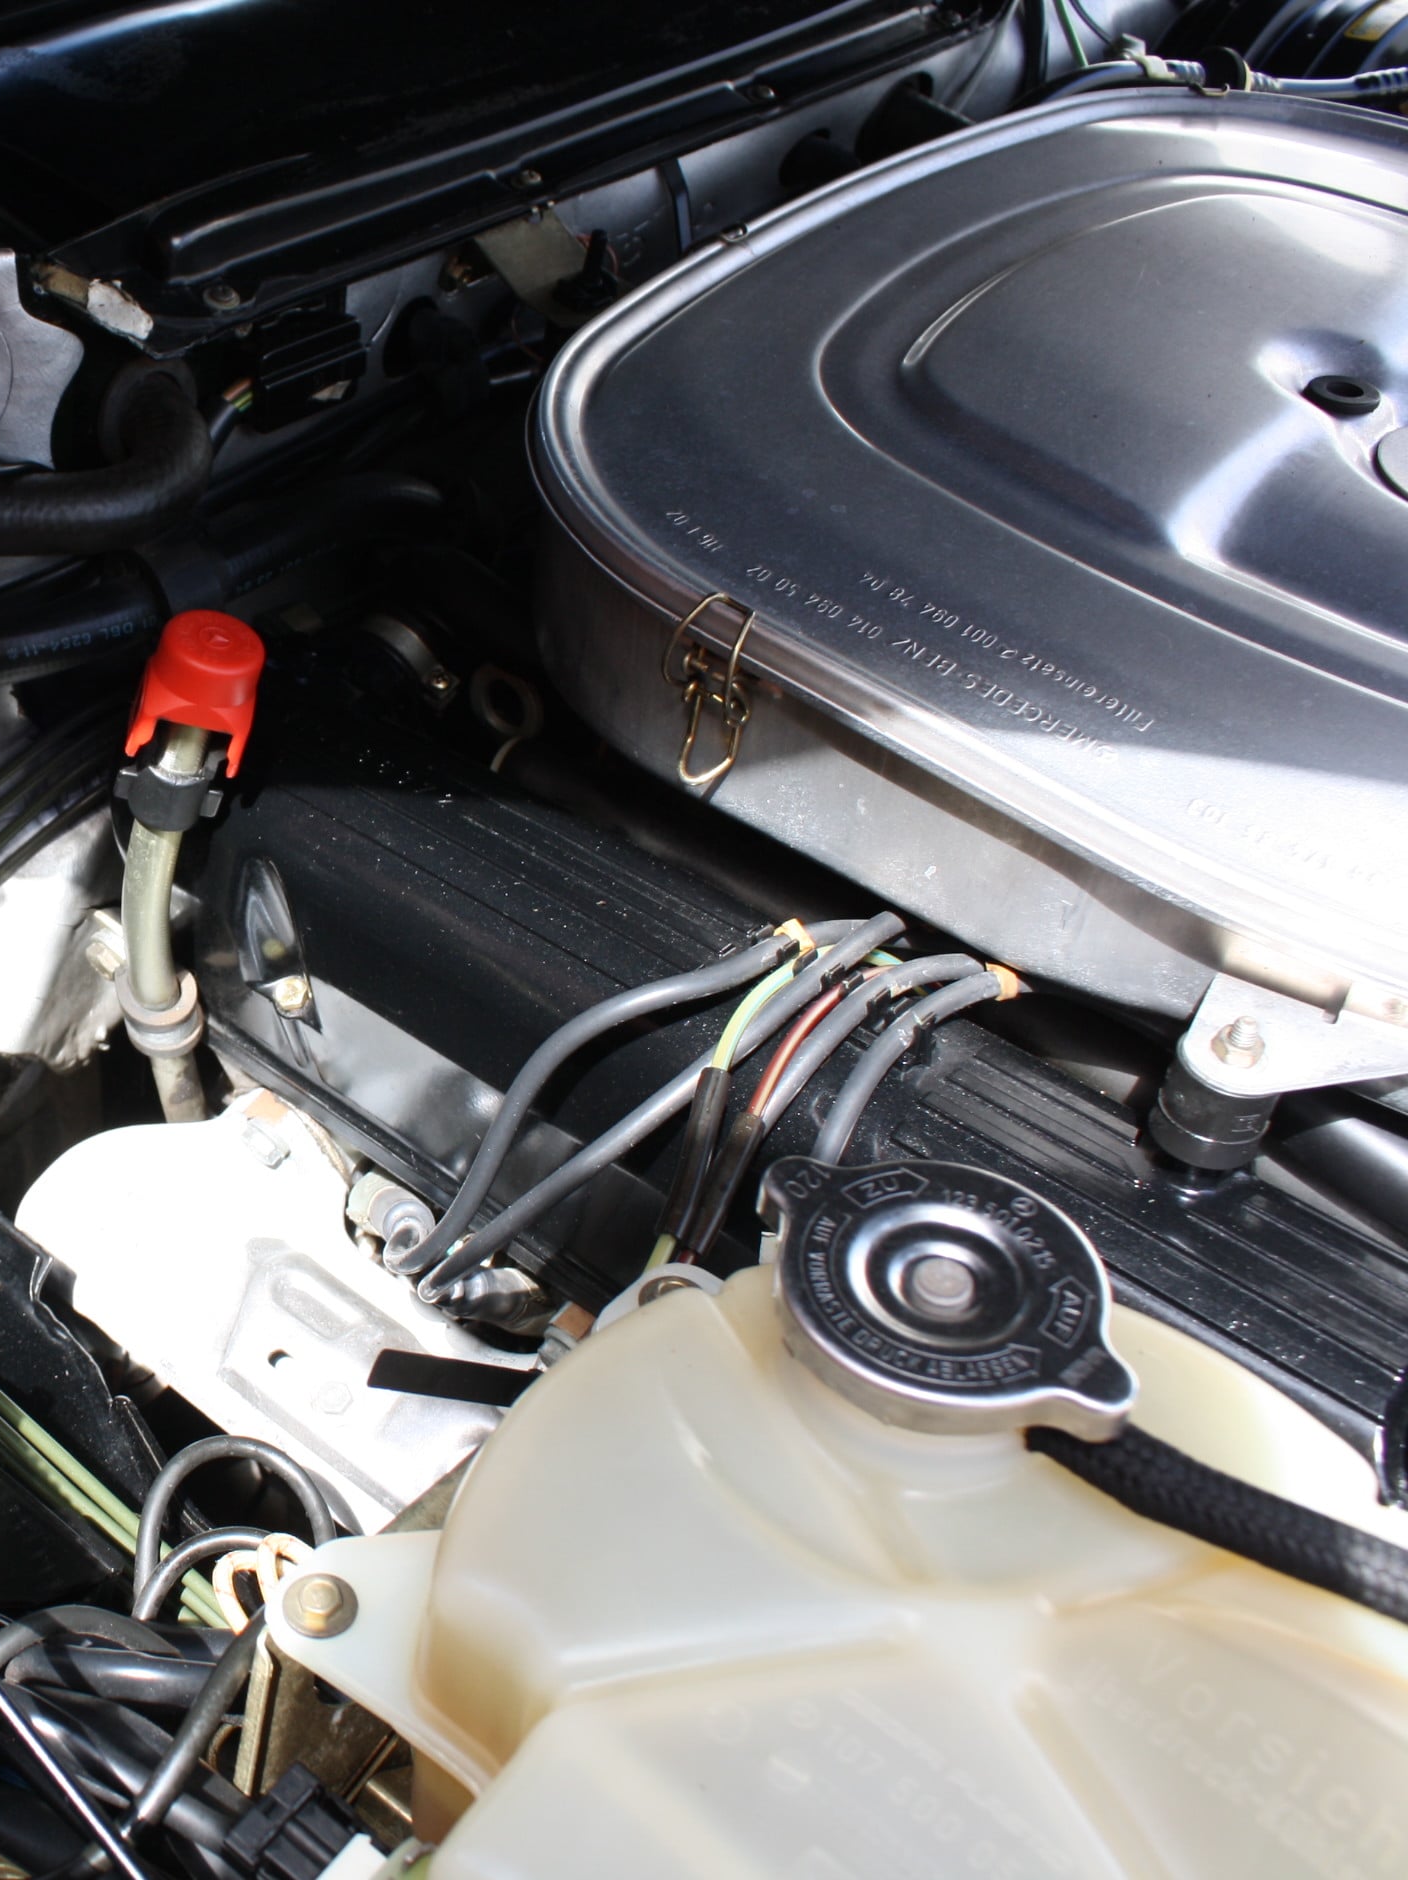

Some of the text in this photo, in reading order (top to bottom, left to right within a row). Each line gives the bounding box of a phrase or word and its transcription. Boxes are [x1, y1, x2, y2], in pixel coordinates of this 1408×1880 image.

[744, 562, 772, 582] 02
[773, 577, 800, 596] 50
[845, 613, 884, 640] 014
[1015, 650, 1155, 732] Filtereinsatz
[784, 1164, 831, 1199] 120
[858, 1176, 899, 1199] ZU
[811, 1215, 837, 1244] AUF
[1052, 1288, 1083, 1336] AUF
